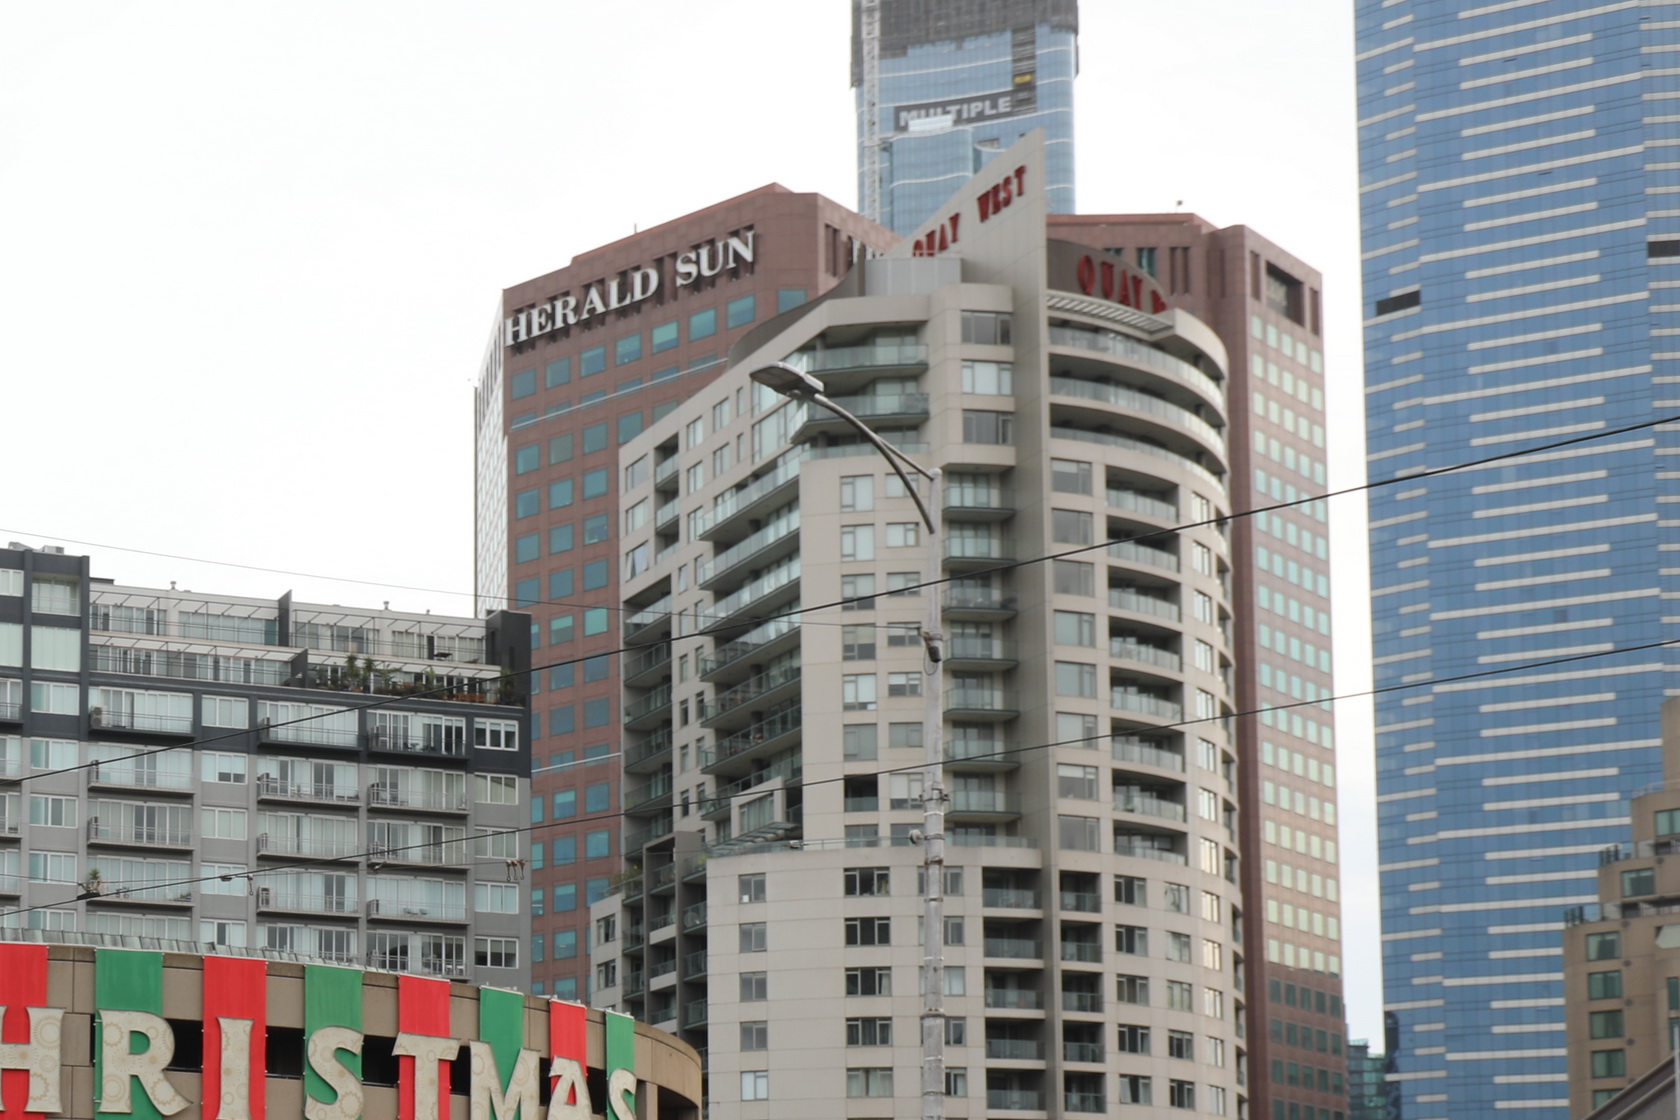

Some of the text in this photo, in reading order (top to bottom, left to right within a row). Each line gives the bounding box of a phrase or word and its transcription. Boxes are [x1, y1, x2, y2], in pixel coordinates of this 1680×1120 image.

[976, 164, 1027, 223] WEST
[504, 229, 757, 348] HERALD SUN
